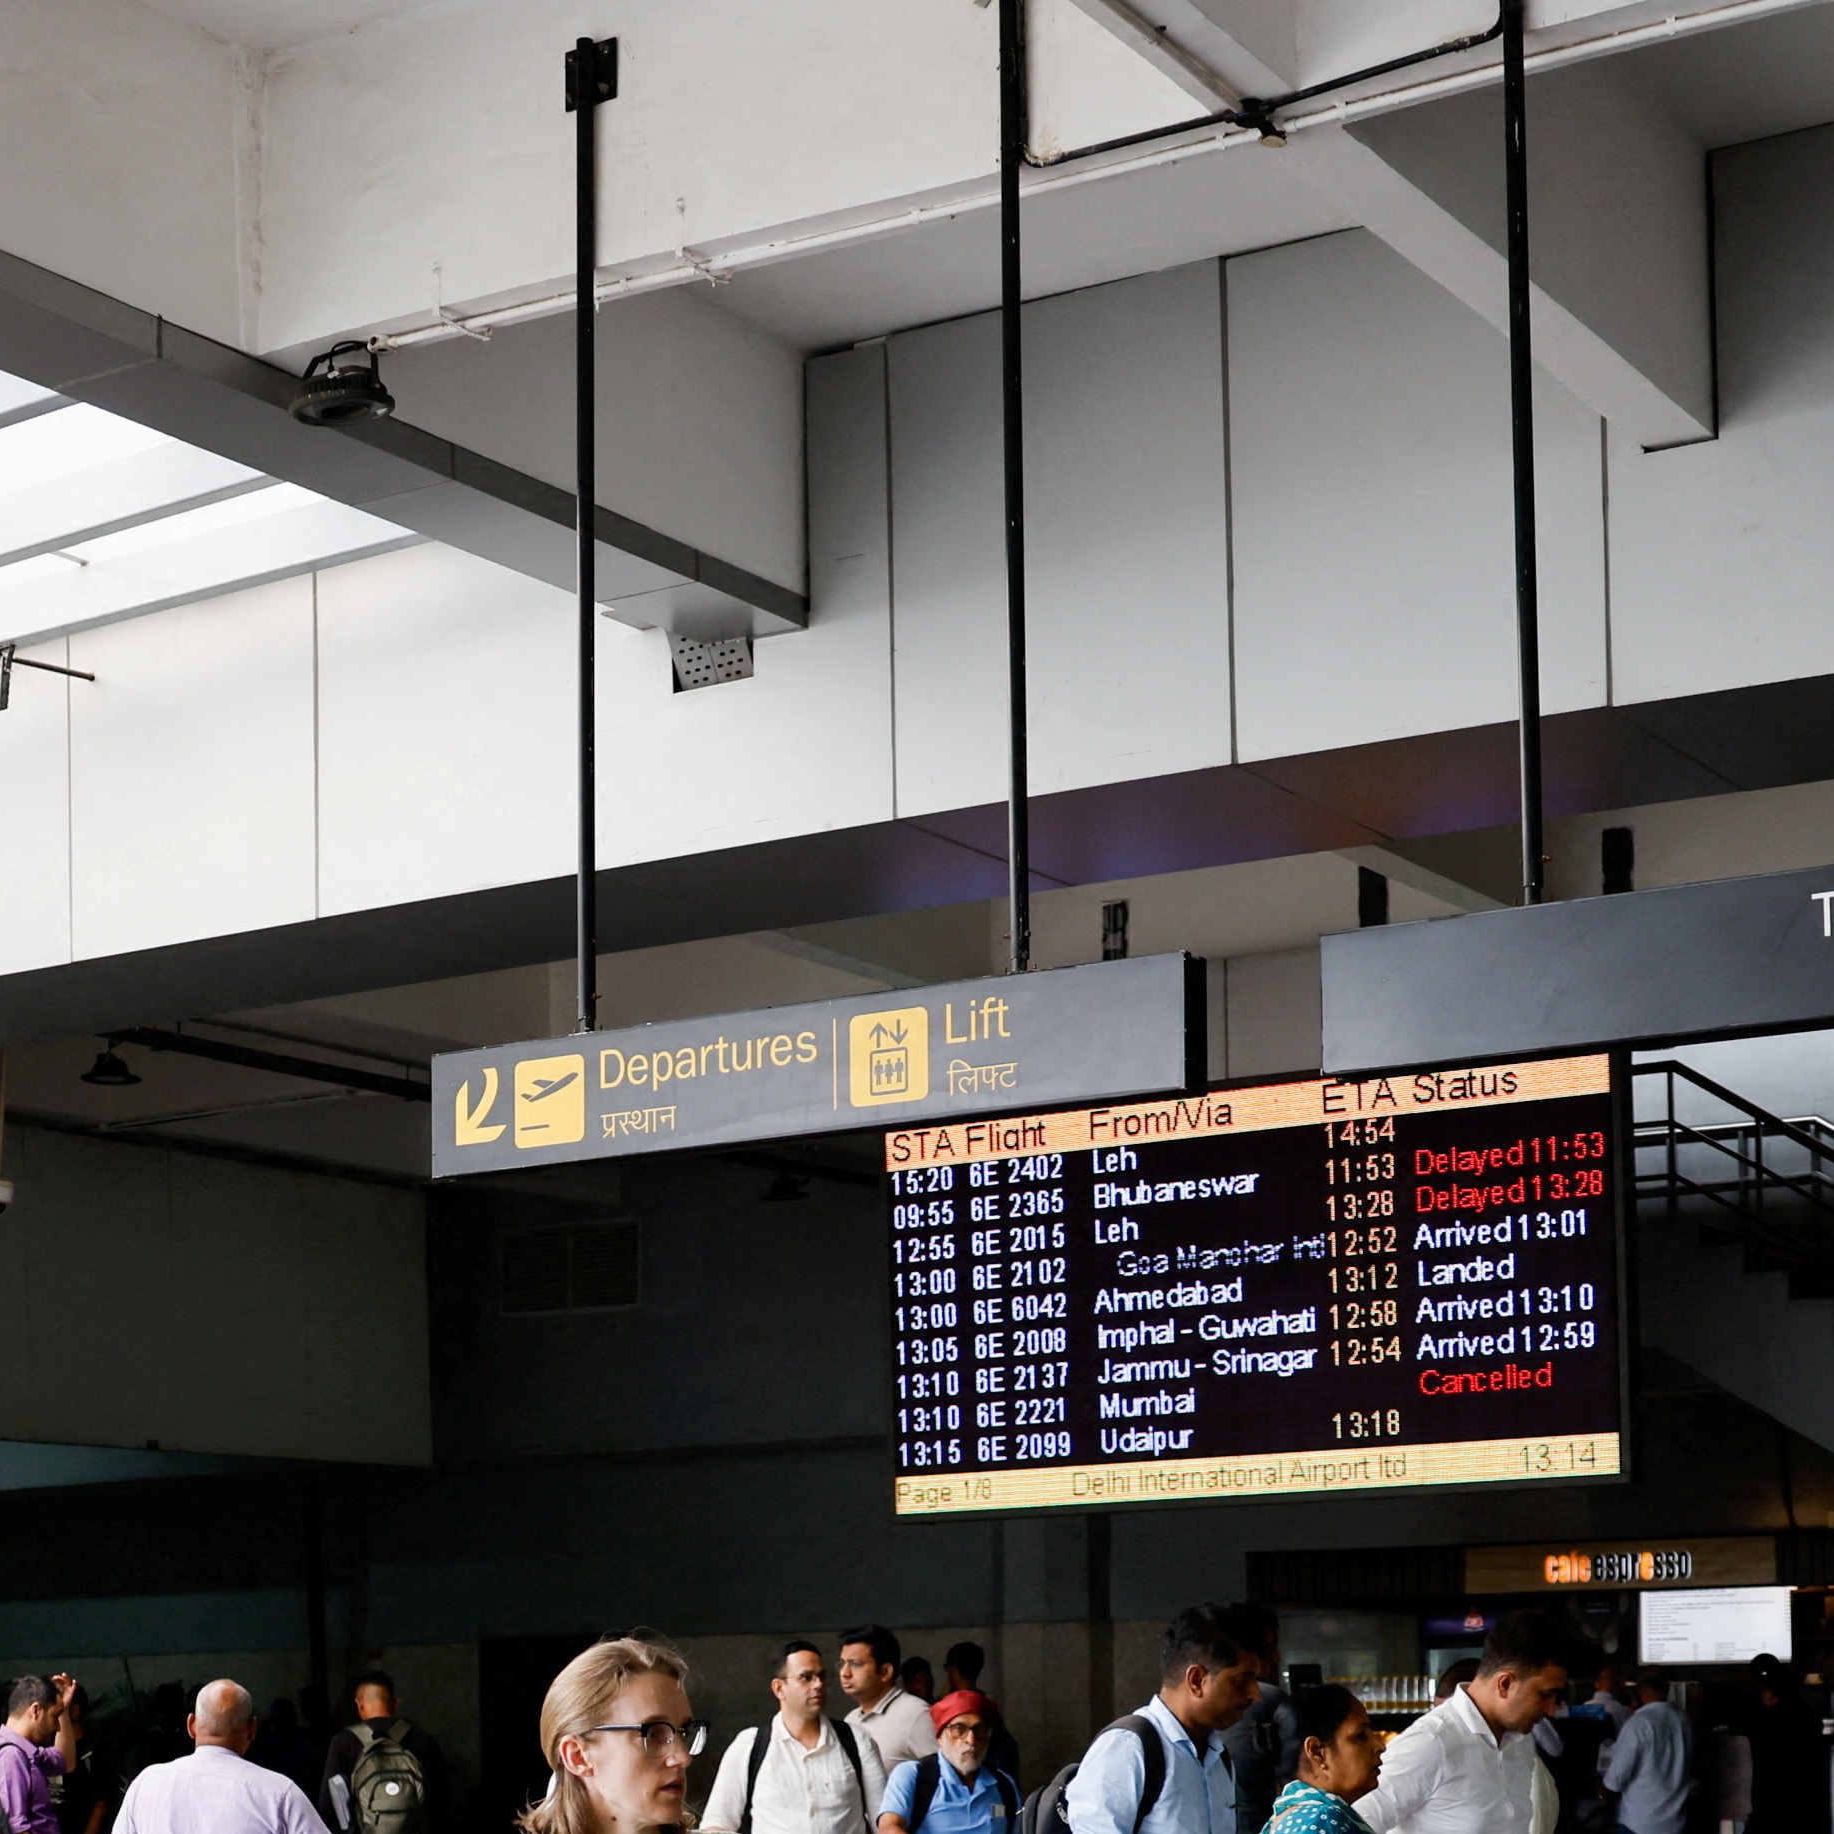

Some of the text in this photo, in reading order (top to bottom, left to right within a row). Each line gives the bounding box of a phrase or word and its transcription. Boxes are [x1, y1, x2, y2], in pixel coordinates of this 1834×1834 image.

[599, 996, 1011, 1093] Departures Lift
[600, 1061, 1018, 1139] प्रस्थान लिफ्ट
[892, 1070, 1519, 1163] STA Flight From/Via ETA Status
[891, 1116, 1396, 1196] 15:20 6E 2402 Leh 14:54
[893, 1131, 1607, 1230] 09:55 6E 2365 Bhubaneswar 11:53 Delayed 11:53
[893, 1169, 1605, 1264] 12:55 6E 2015 Leh 13:28 Delayed 13:28
[894, 1268, 957, 1298] 13:00
[972, 1263, 1003, 1291] 6E
[1011, 1257, 1067, 1288] 2102
[1117, 1250, 1170, 1277] Goa
[1327, 1226, 1398, 1259] 12:52
[1413, 1215, 1513, 1250] Arrived
[1518, 1209, 1589, 1241] 13:01
[895, 1253, 1515, 1332] 13:00 6E 6042 Ahmedabad 13:12 Landed
[896, 1336, 959, 1366] 13:05
[974, 1332, 1005, 1359] 6E
[1013, 1328, 1067, 1356] 2008
[1097, 1318, 1176, 1353] Imphal
[1198, 1306, 1317, 1341] Guwahati
[1329, 1299, 1398, 1330] 12:58
[1415, 1290, 1514, 1324] Arrived
[1519, 1283, 1595, 1315] 13:10
[897, 1370, 960, 1399] 13:10
[975, 1366, 1006, 1393] 6E
[1014, 1362, 1069, 1391] 2137
[1097, 1358, 1191, 1385] Jammu
[1212, 1347, 1319, 1377] Srinagar
[1330, 1336, 1402, 1367] 12:54
[1416, 1328, 1515, 1361] Arrived
[1520, 1321, 1595, 1353] 12:59
[898, 1361, 1554, 1434] 13:10 6E 2221 Mumbai Cancelled
[896, 1441, 1597, 1508] Page 1/8 Delhi International Airport ltd 13:14
[899, 1409, 1401, 1467] 13:15 6E 2099 Udaipur 13:18
[1594, 1550, 1693, 1583] espresso
